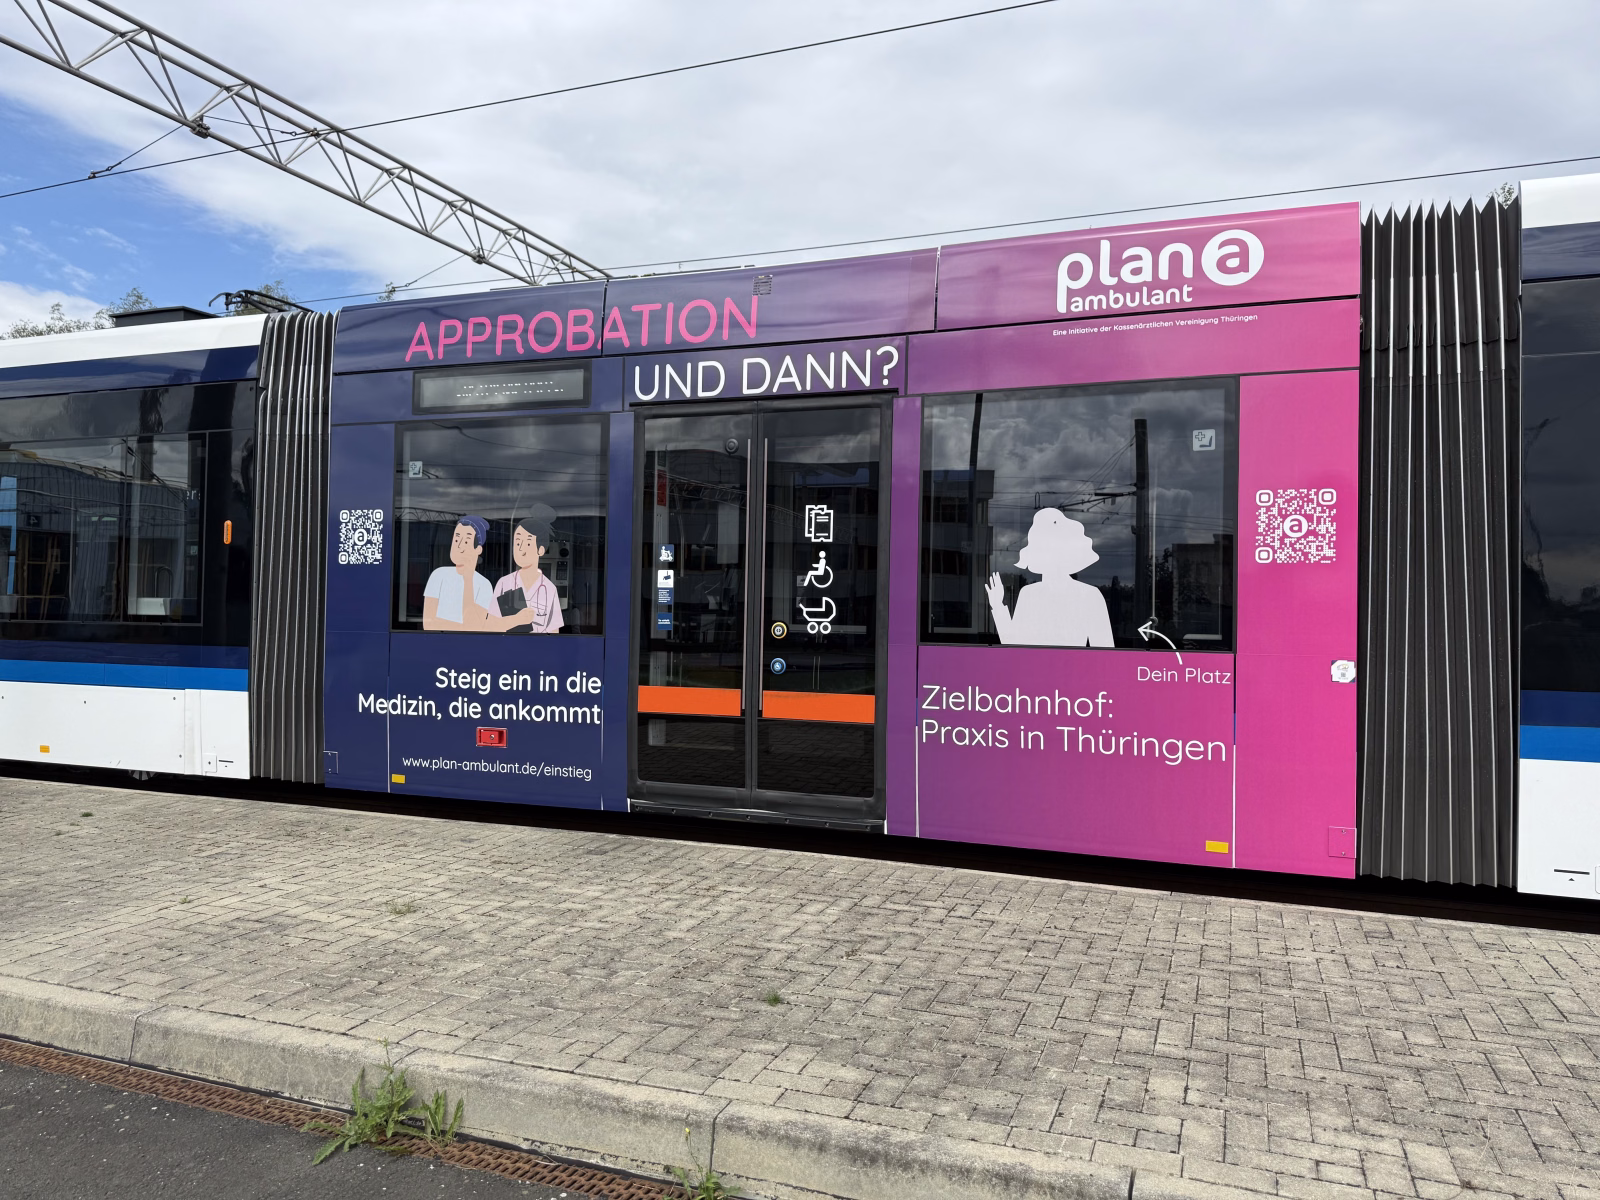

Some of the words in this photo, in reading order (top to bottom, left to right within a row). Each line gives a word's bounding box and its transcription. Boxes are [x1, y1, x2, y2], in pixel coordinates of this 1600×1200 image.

[1056, 239, 1194, 314] plan
[1070, 283, 1193, 313] ambulant
[404, 294, 760, 363] APPROBATION
[1068, 326, 1099, 335] Initiative
[1113, 319, 1174, 331] Kassenärztlichen
[1175, 317, 1219, 326] Vereinigung
[1220, 313, 1258, 323] Thüringen
[633, 359, 726, 401] UND
[742, 344, 899, 396] DANN?
[435, 667, 491, 695] Steig
[498, 669, 532, 691] ein
[539, 670, 558, 692] in
[566, 671, 602, 694] die
[1137, 666, 1179, 683] Dein
[1185, 667, 1232, 684] Platz
[358, 692, 443, 720] Medizin,
[448, 696, 482, 719] die
[488, 699, 601, 725] ankommt
[921, 684, 1114, 718] Zielbahnhof:
[921, 719, 1009, 748] Praxis
[1019, 725, 1044, 750] in
[1056, 726, 1227, 765] Thüringen
[402, 756, 592, 782] www.plan-ambulant.de/einstieg
